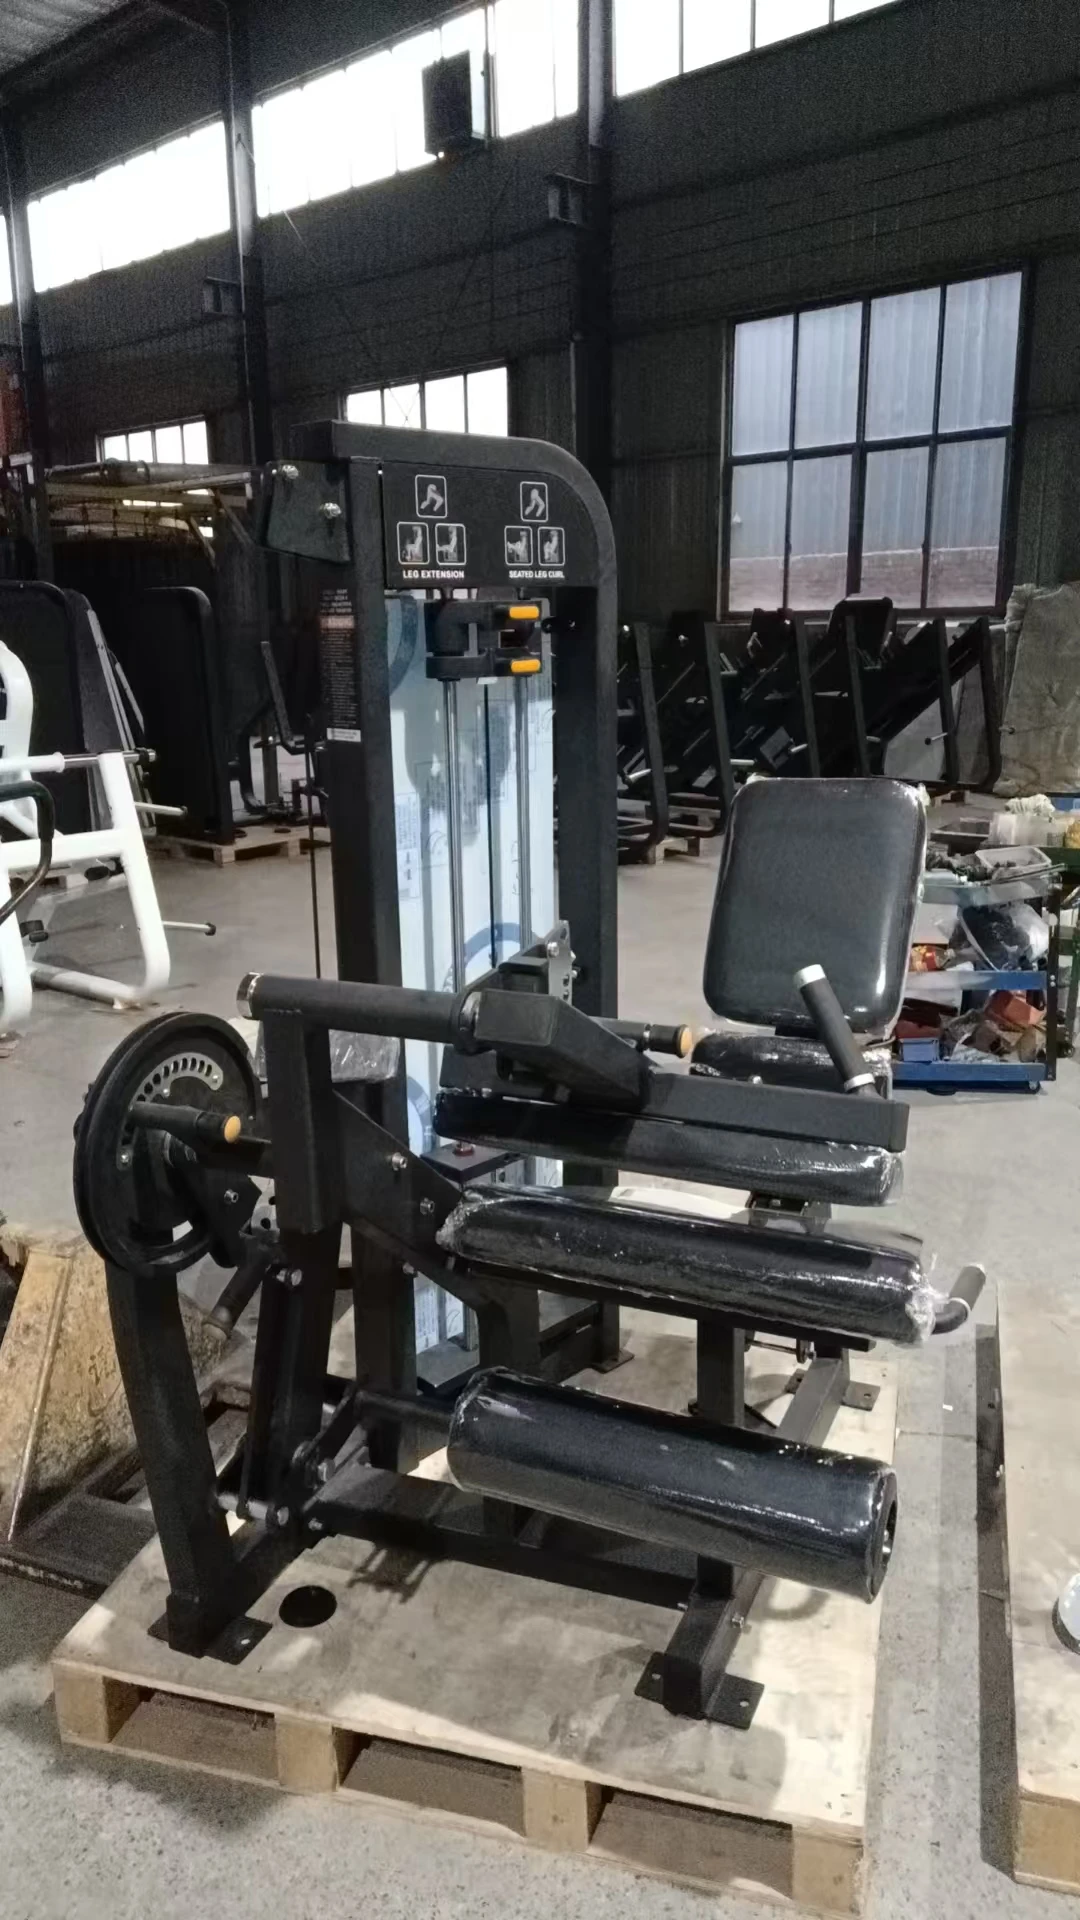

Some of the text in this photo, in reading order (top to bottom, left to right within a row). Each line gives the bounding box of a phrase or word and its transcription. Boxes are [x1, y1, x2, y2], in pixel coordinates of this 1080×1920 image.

[402, 569, 465, 580] LEG EXTENSION
[508, 570, 534, 579] SEATED
[534, 570, 547, 579] LEG
